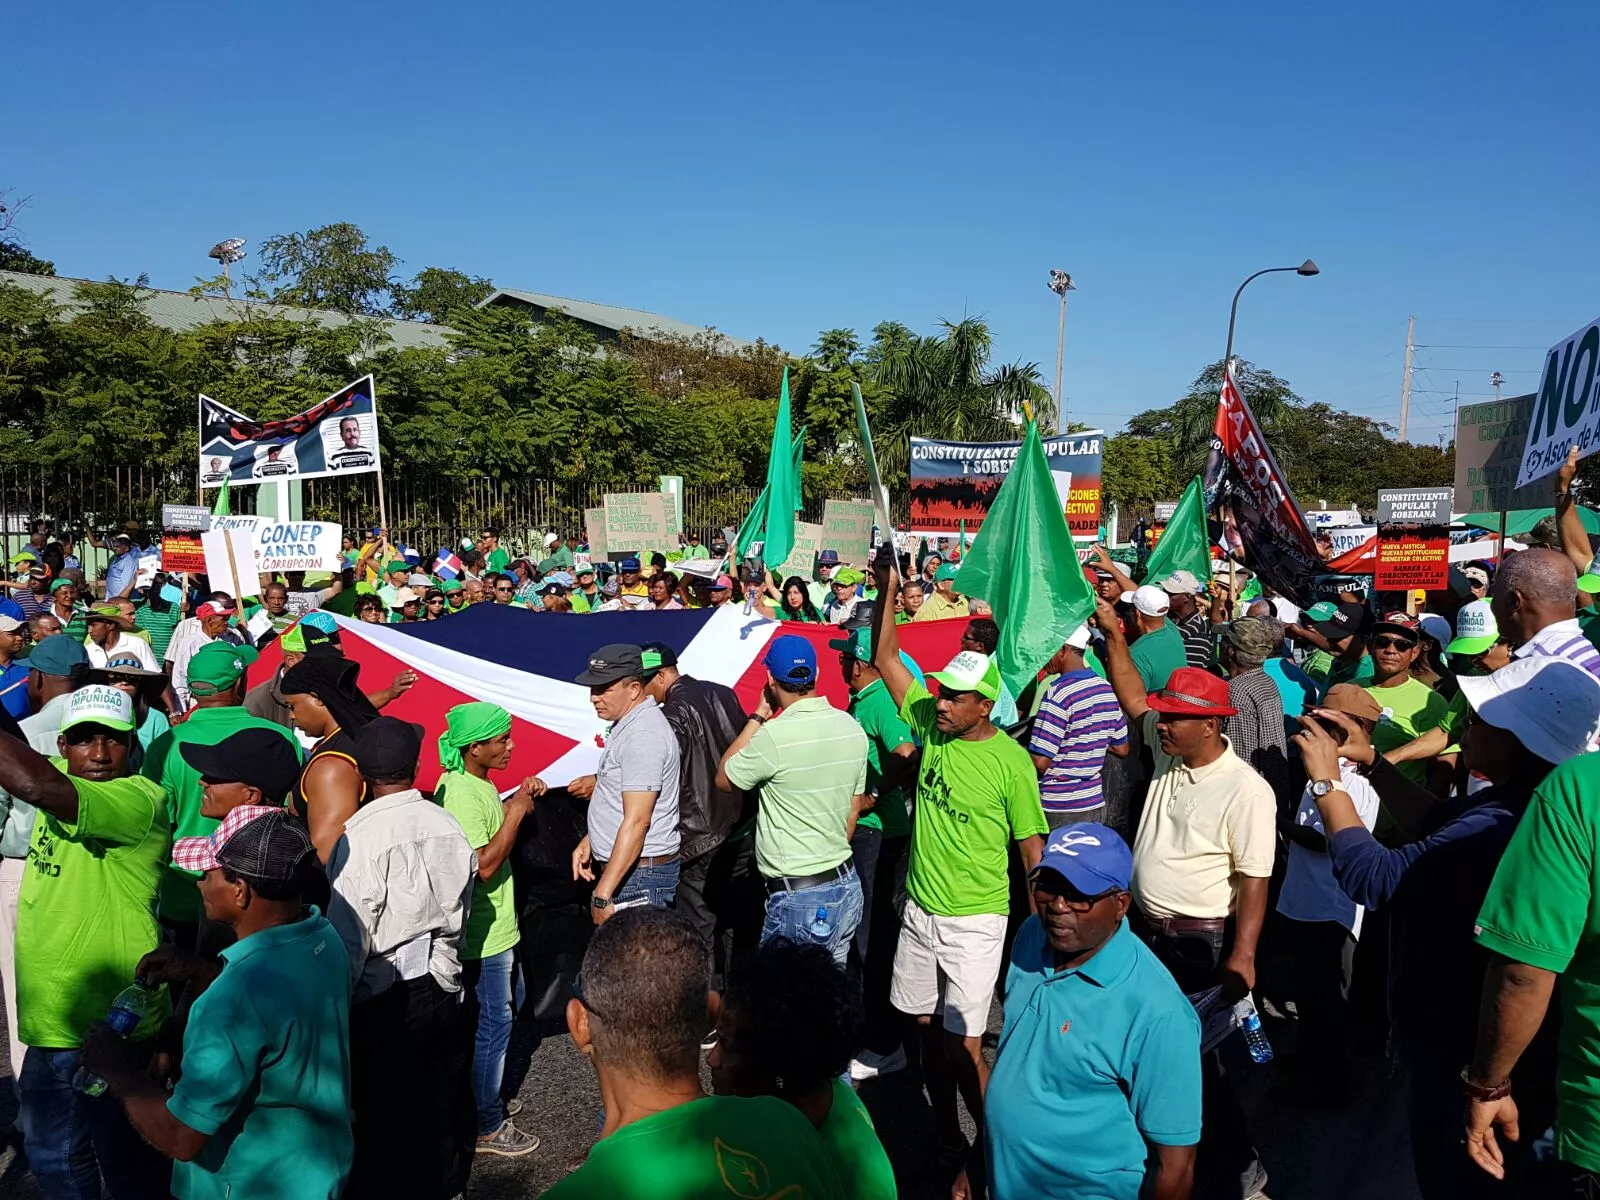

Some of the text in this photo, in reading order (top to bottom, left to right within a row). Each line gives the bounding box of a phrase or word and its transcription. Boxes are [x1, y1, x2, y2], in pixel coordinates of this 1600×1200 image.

[1531, 326, 1600, 446] NO
[1577, 423, 1591, 452] de
[911, 445, 1019, 460] CONSTITUYENTE
[961, 461, 969, 474] Y
[1381, 492, 1449, 502] CONSTITUYENTE
[1391, 502, 1430, 510] POPULAR
[1391, 510, 1436, 518] SOBERANA
[911, 518, 940, 527] BARRER
[942, 518, 953, 527] LA
[1069, 520, 1099, 530] DADES
[261, 524, 323, 544] CONEP
[264, 544, 317, 557] ANTRO
[262, 557, 323, 570] CORRUPCION
[968, 656, 978, 665] LA
[71, 693, 122, 707] IMPUNIDAD
[72, 688, 89, 699] NO
[106, 689, 122, 699] LA
[1049, 830, 1101, 857] L
